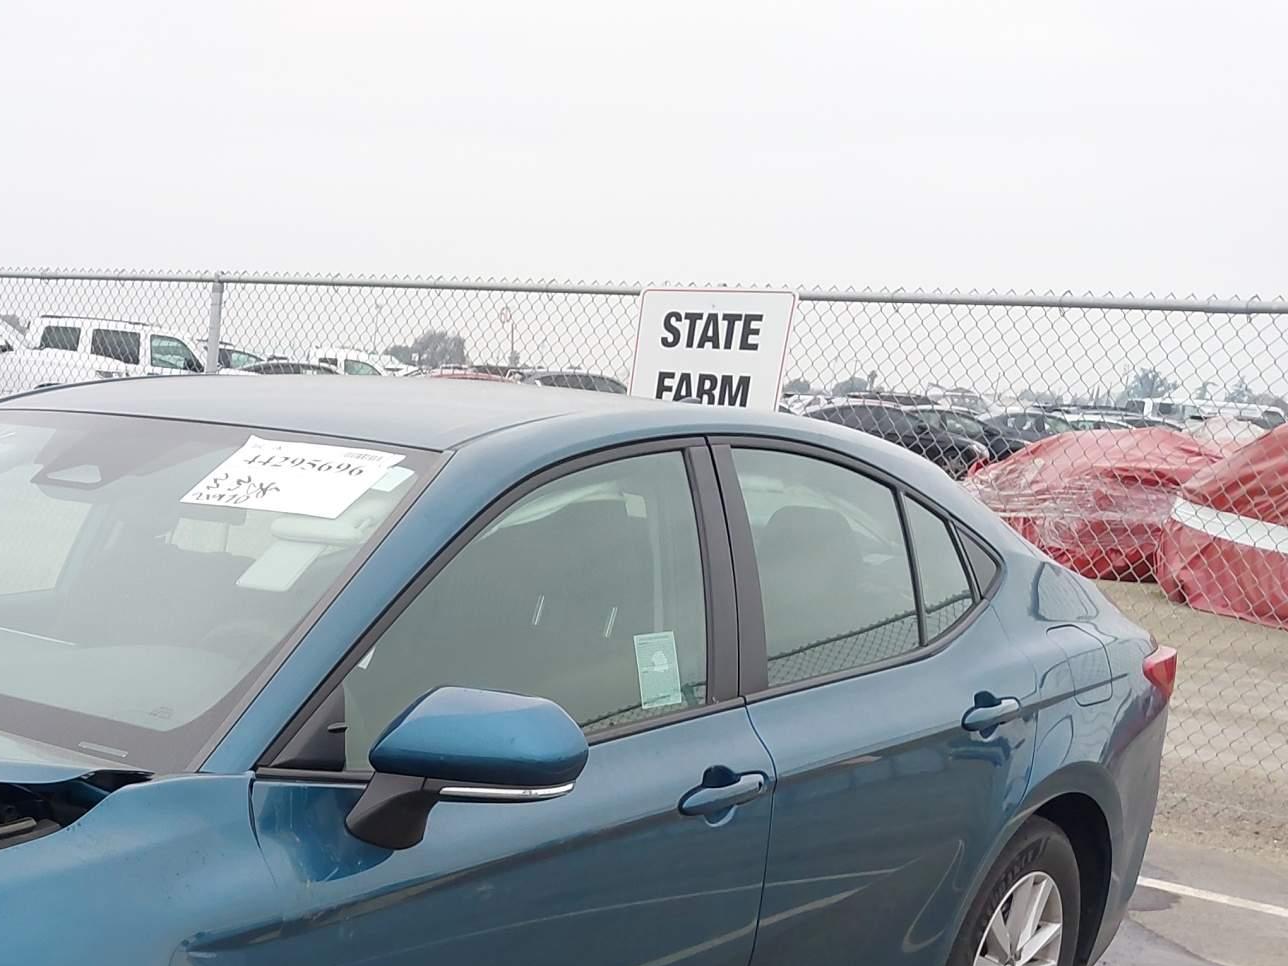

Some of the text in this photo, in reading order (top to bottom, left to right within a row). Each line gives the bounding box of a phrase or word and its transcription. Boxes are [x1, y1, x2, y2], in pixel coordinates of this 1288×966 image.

[660, 311, 764, 352] STATE
[655, 371, 752, 408] FARM
[242, 453, 365, 478] 44295696
